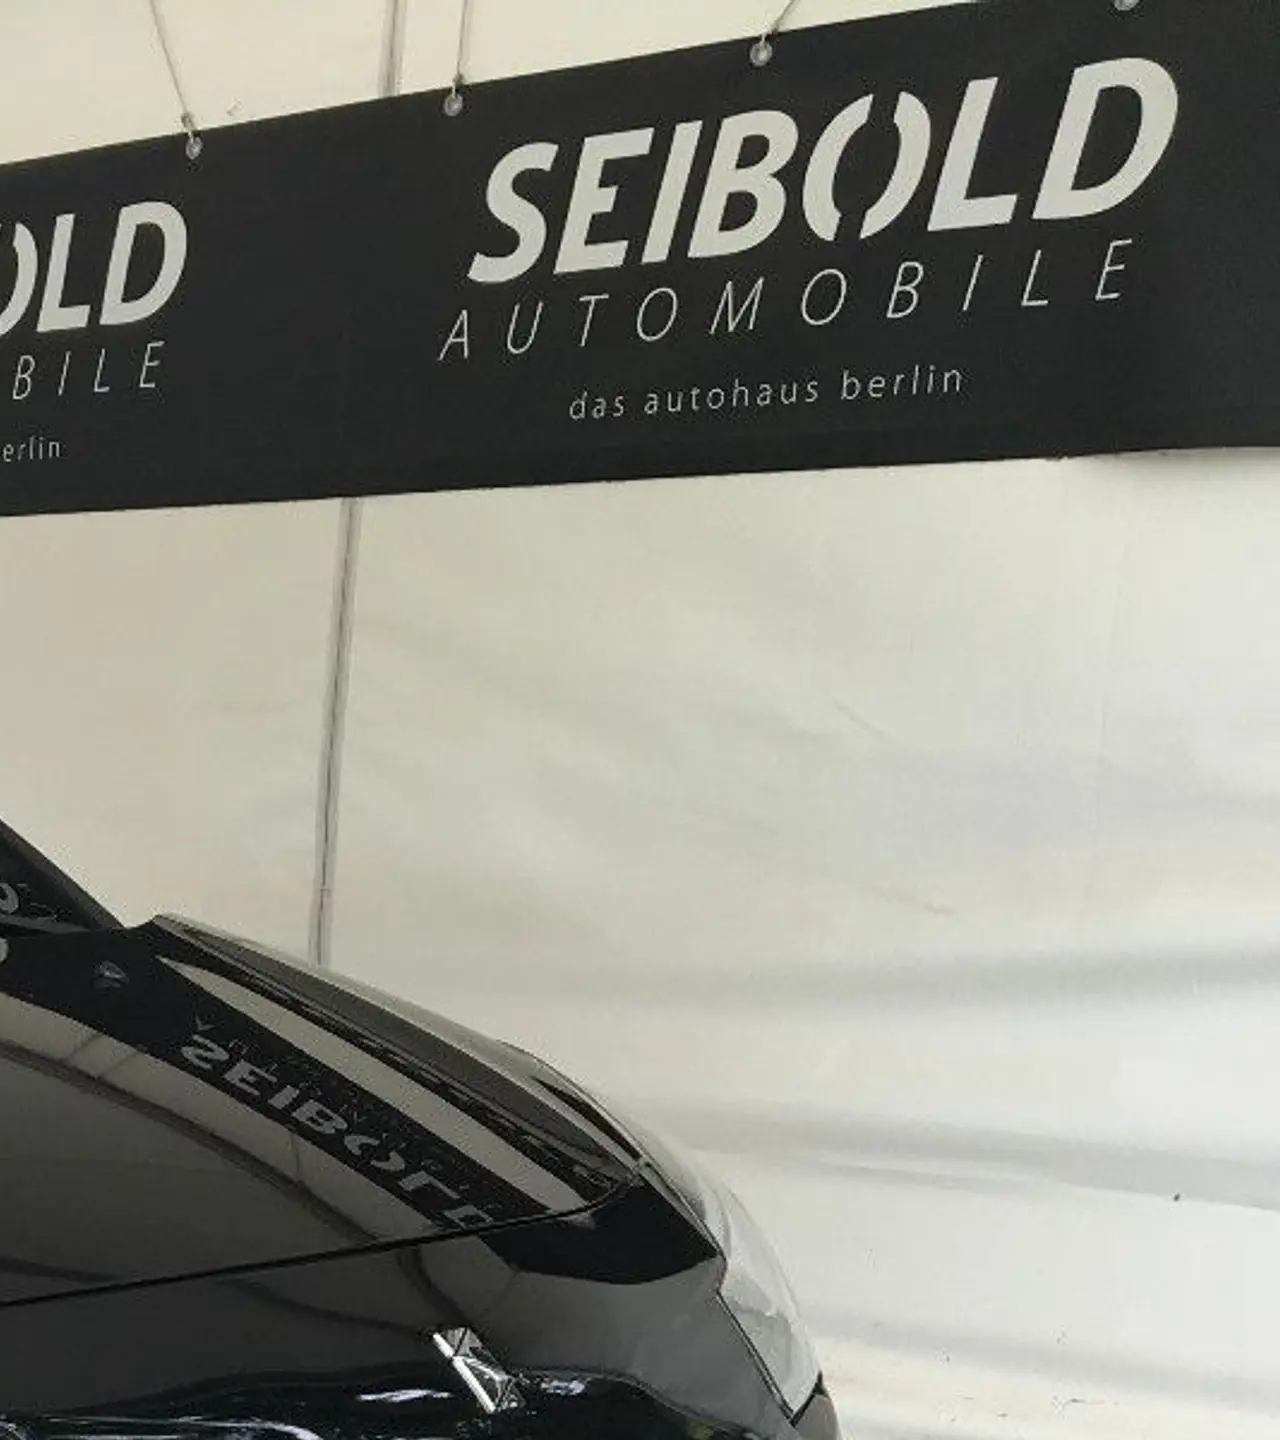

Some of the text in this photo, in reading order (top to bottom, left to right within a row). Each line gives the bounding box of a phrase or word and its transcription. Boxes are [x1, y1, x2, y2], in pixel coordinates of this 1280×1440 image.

[466, 57, 1180, 284] SEIBOLD
[438, 238, 1134, 361] AUTOMOBILE
[569, 364, 963, 421] das autohaus berlin
